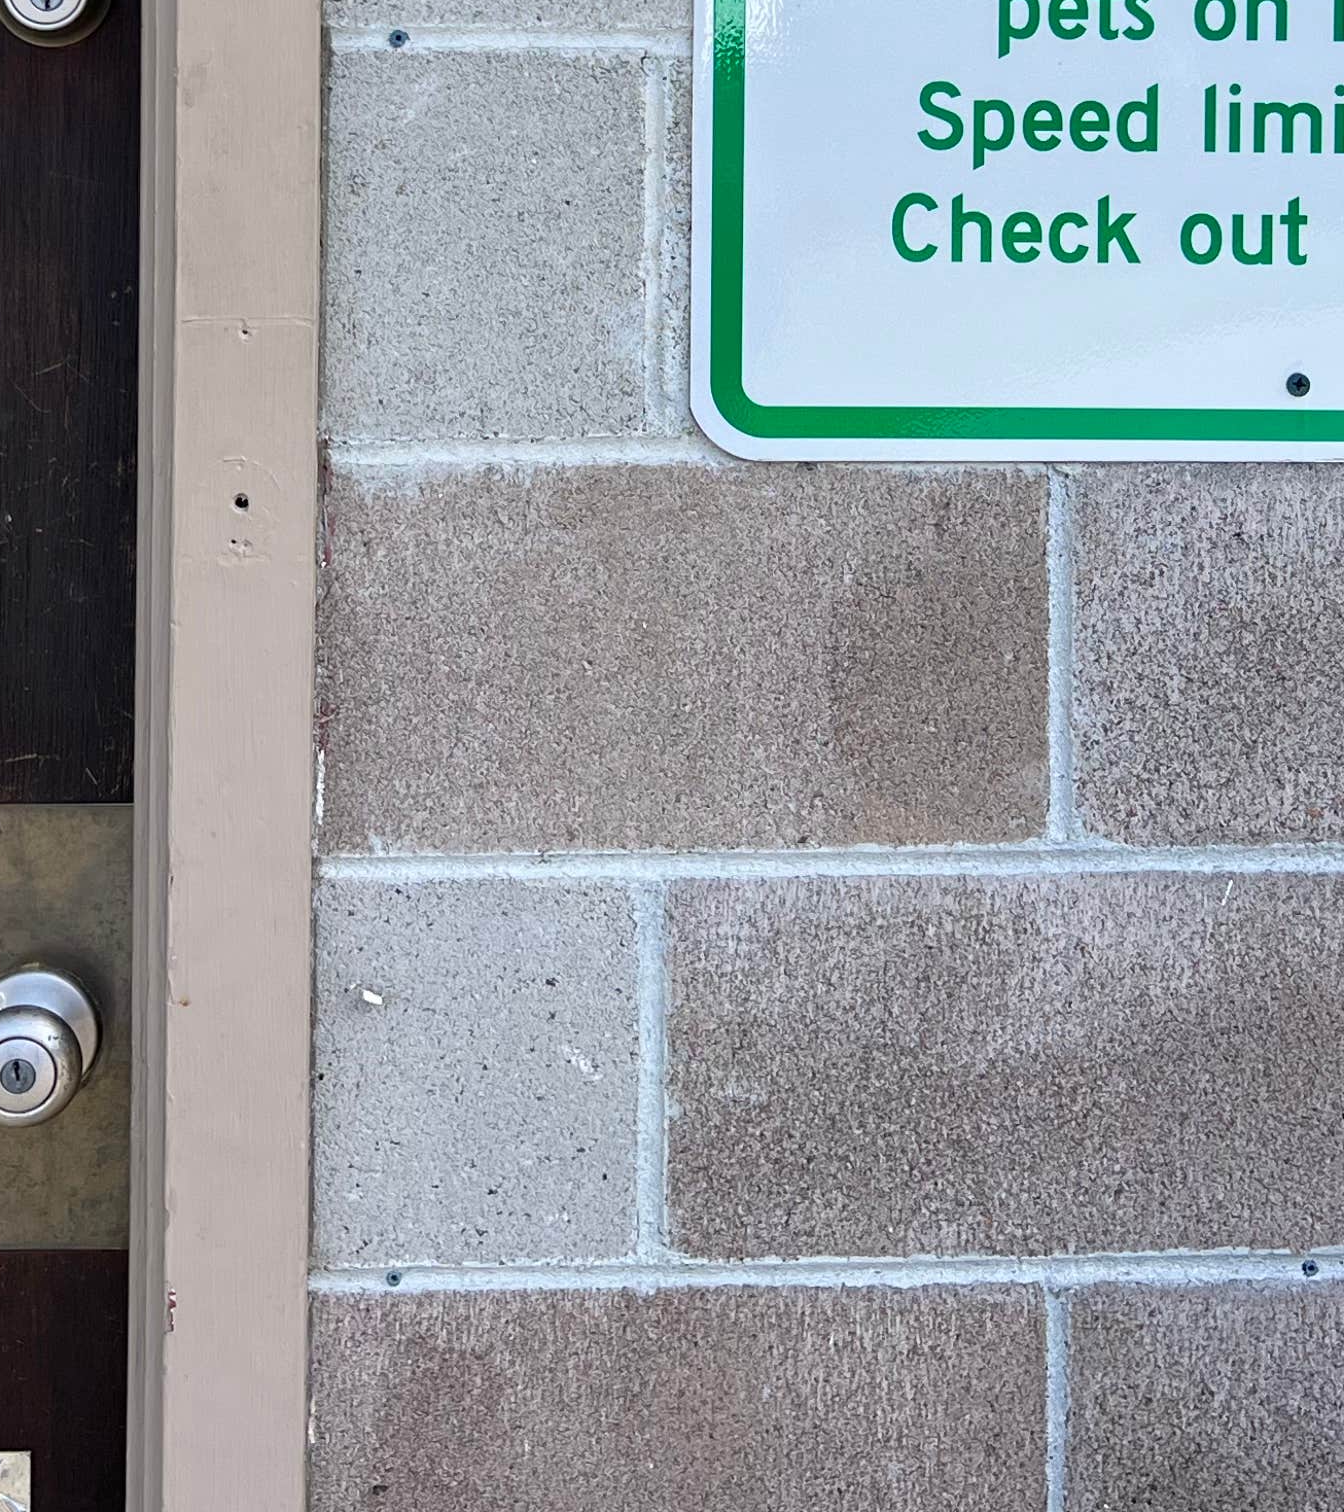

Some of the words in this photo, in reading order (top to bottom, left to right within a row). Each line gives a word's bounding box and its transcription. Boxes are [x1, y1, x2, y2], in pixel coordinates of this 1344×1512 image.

[916, 79, 1161, 169] Speed
[890, 191, 1141, 264] Check
[1179, 195, 1310, 268] out
